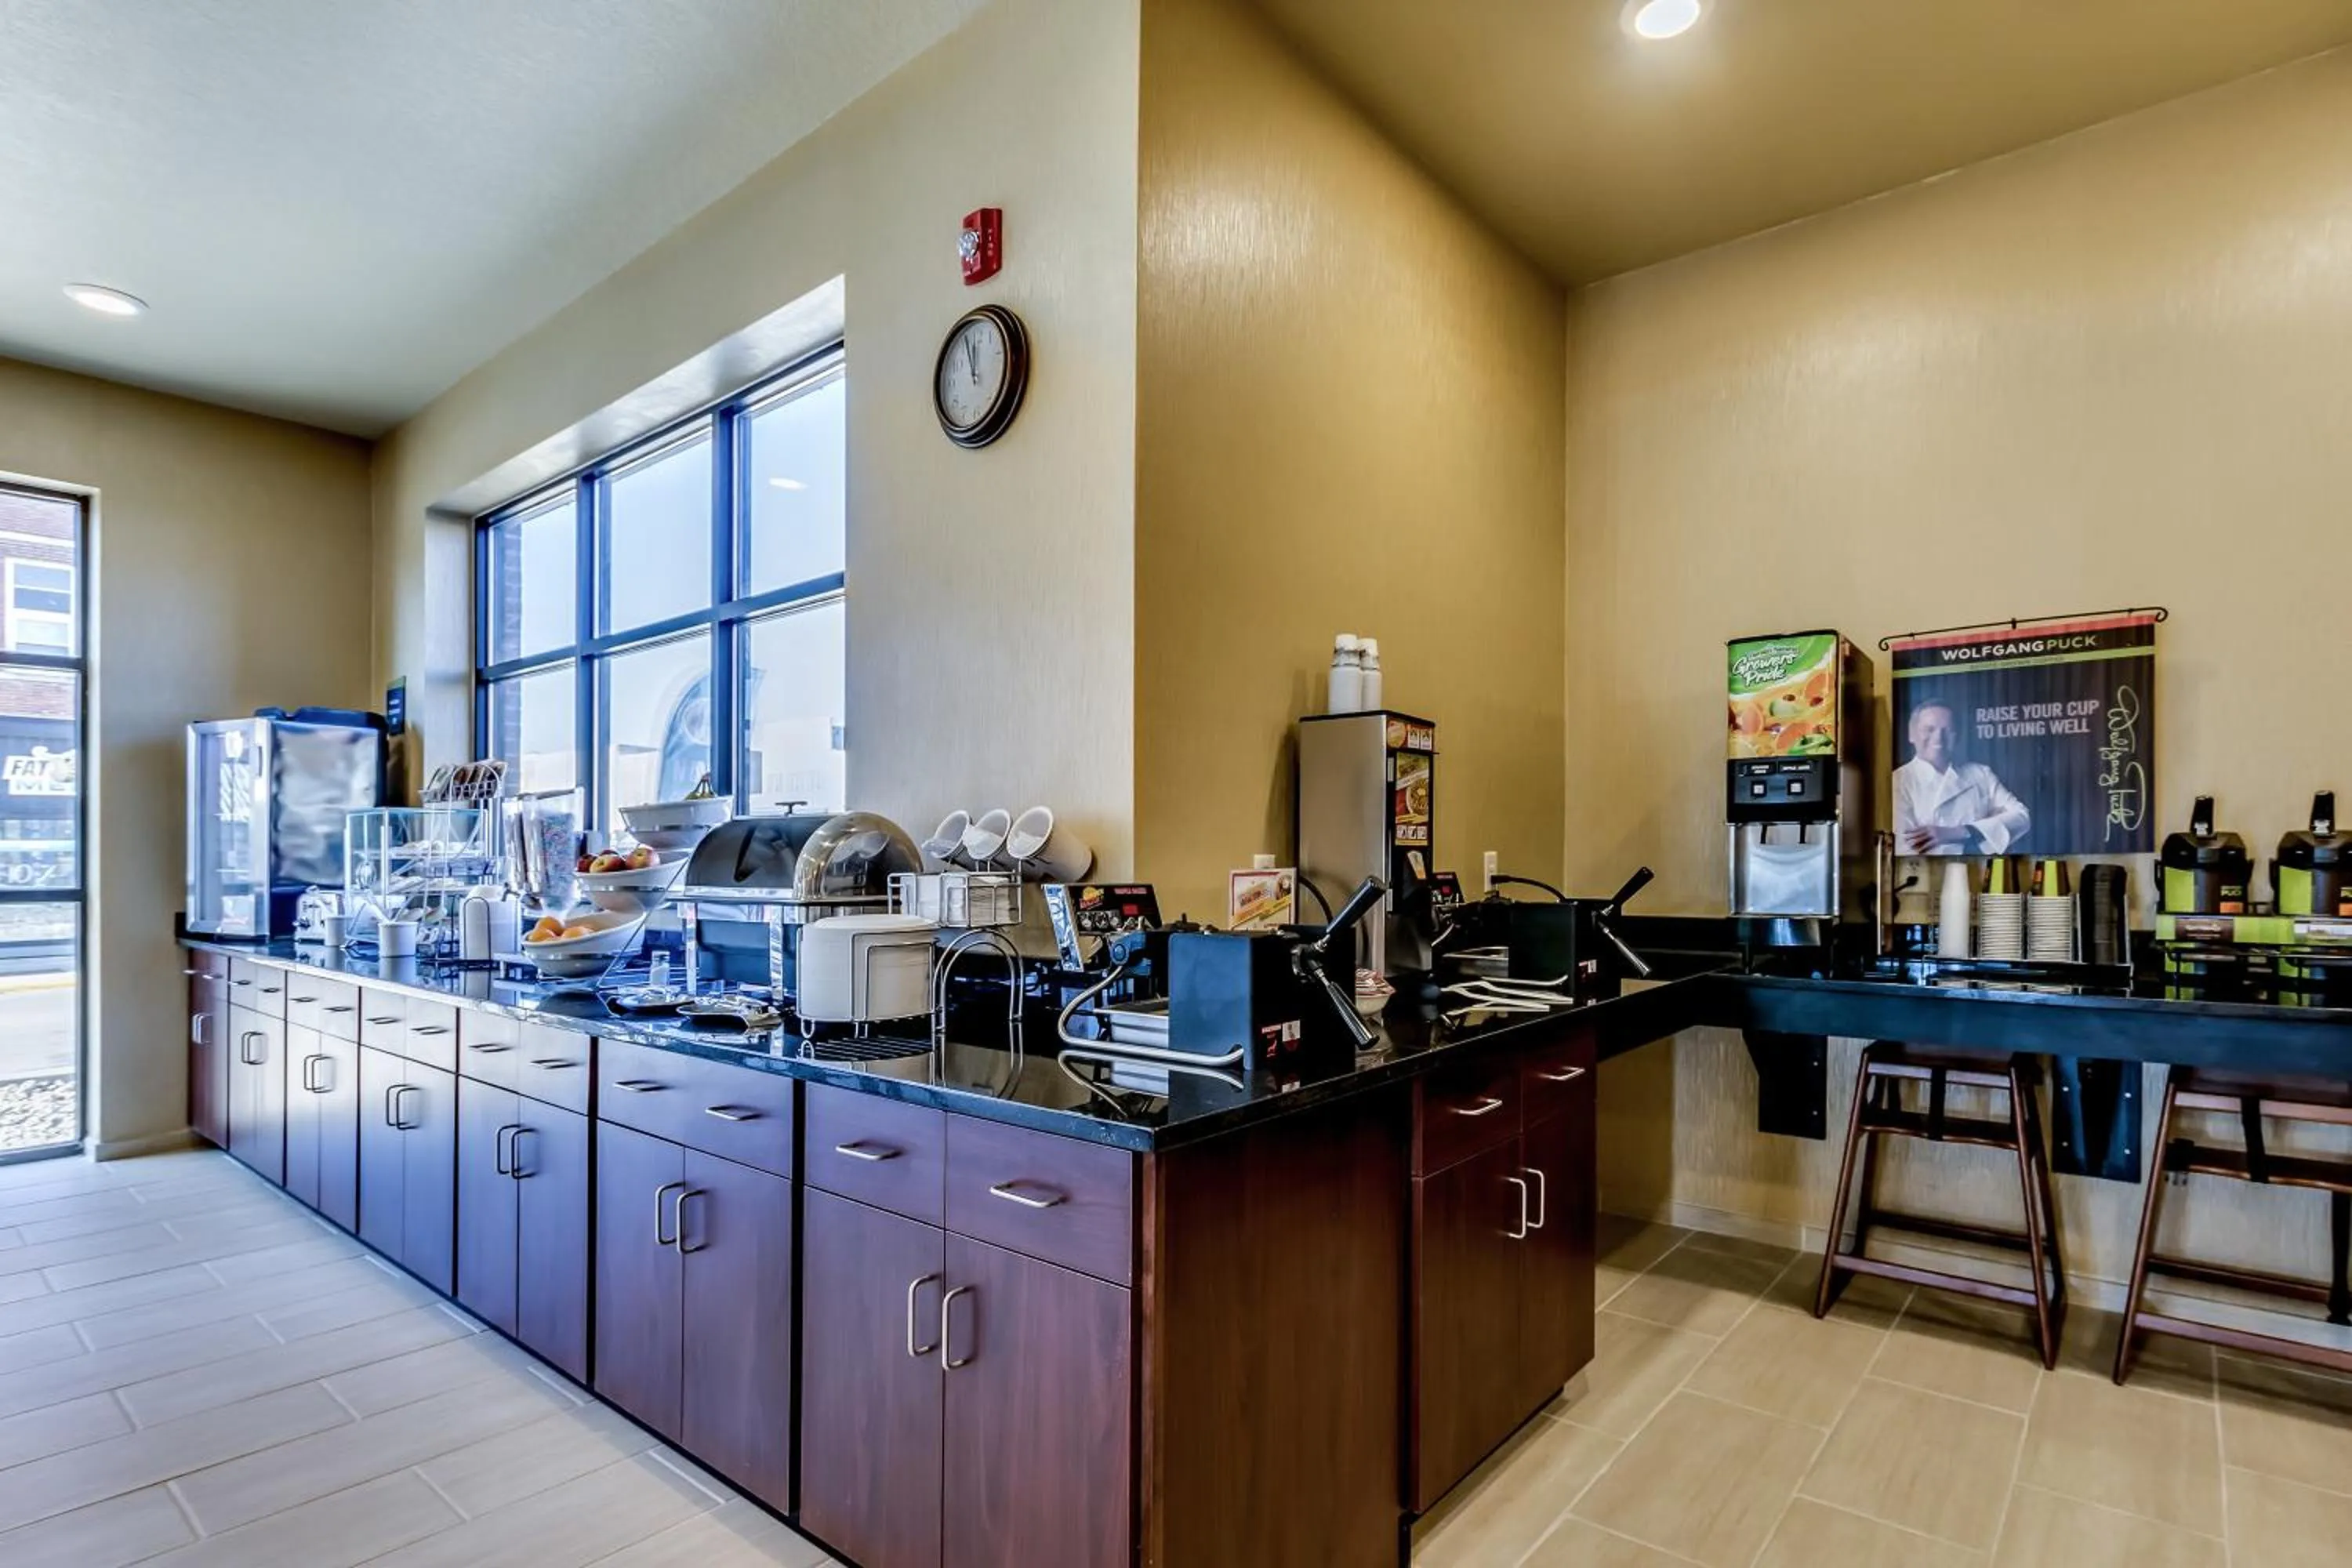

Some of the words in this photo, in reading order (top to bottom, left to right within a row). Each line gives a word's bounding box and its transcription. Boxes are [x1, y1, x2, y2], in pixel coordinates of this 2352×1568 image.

[1975, 707, 2019, 723] RAISE
[2022, 702, 2063, 720] YOUR
[2067, 699, 2100, 717] CUP
[1976, 724, 1994, 739] TO
[1998, 720, 2045, 738] LIVING
[2049, 718, 2091, 735] WELL
[11, 759, 49, 776] FAT
